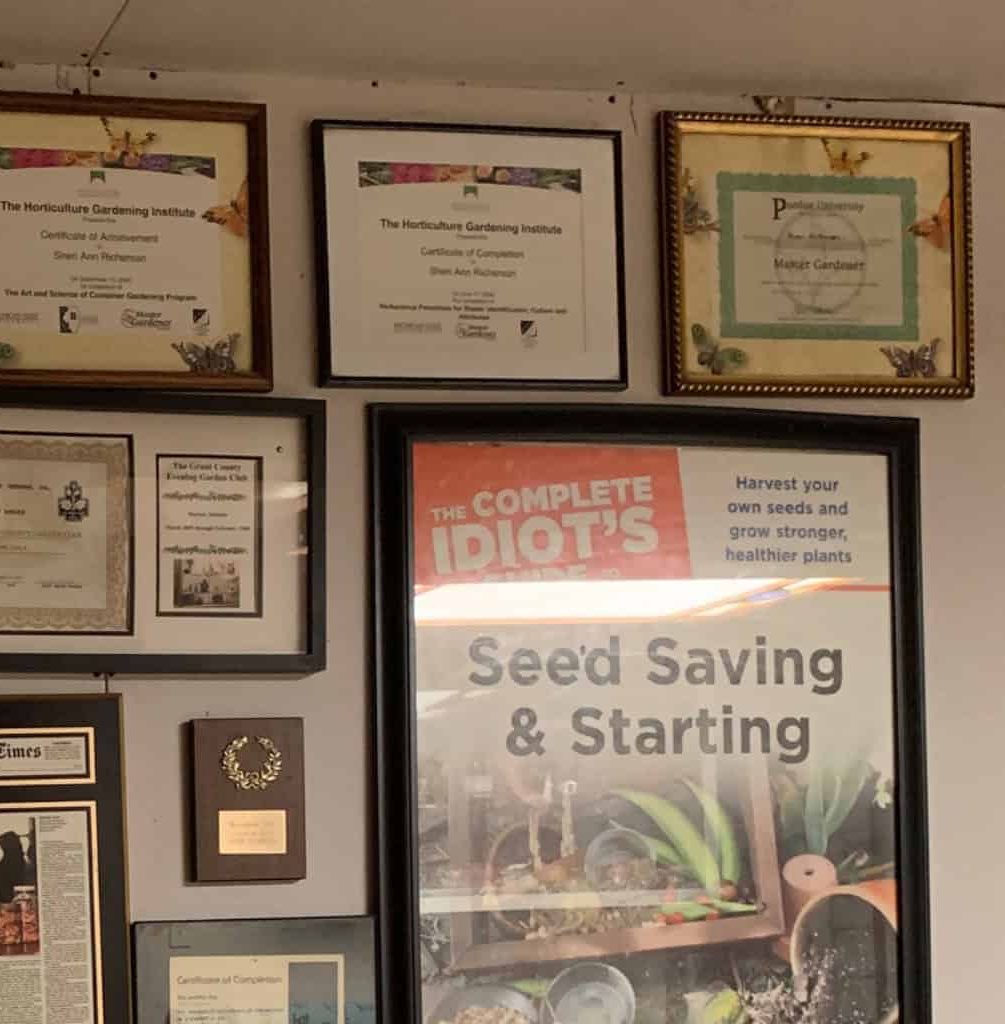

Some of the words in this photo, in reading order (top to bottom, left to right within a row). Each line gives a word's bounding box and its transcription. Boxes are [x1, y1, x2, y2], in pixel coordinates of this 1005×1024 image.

[1, 201, 22, 211] The
[24, 202, 89, 214] Horticulture
[92, 204, 149, 218] Gardening
[152, 207, 196, 218] Institute
[380, 219, 399, 229] The
[402, 220, 462, 231] Horticulture
[465, 222, 519, 234] Gardening
[521, 224, 563, 234] Institute
[736, 476, 797, 492] Harvest
[802, 478, 839, 493] your
[431, 504, 467, 521] THE
[472, 475, 654, 518] COMPLETE
[727, 502, 762, 516] own
[767, 500, 813, 516] seeds
[818, 501, 849, 516] and
[431, 506, 659, 576] IDIOT'S
[729, 525, 771, 541] grow
[776, 525, 848, 541] stronger,
[725, 548, 798, 563] healthier
[802, 549, 852, 566] plants
[468, 636, 620, 687] Seed
[647, 635, 844, 695] Saving
[506, 707, 545, 756] &
[572, 705, 811, 764] Starting
